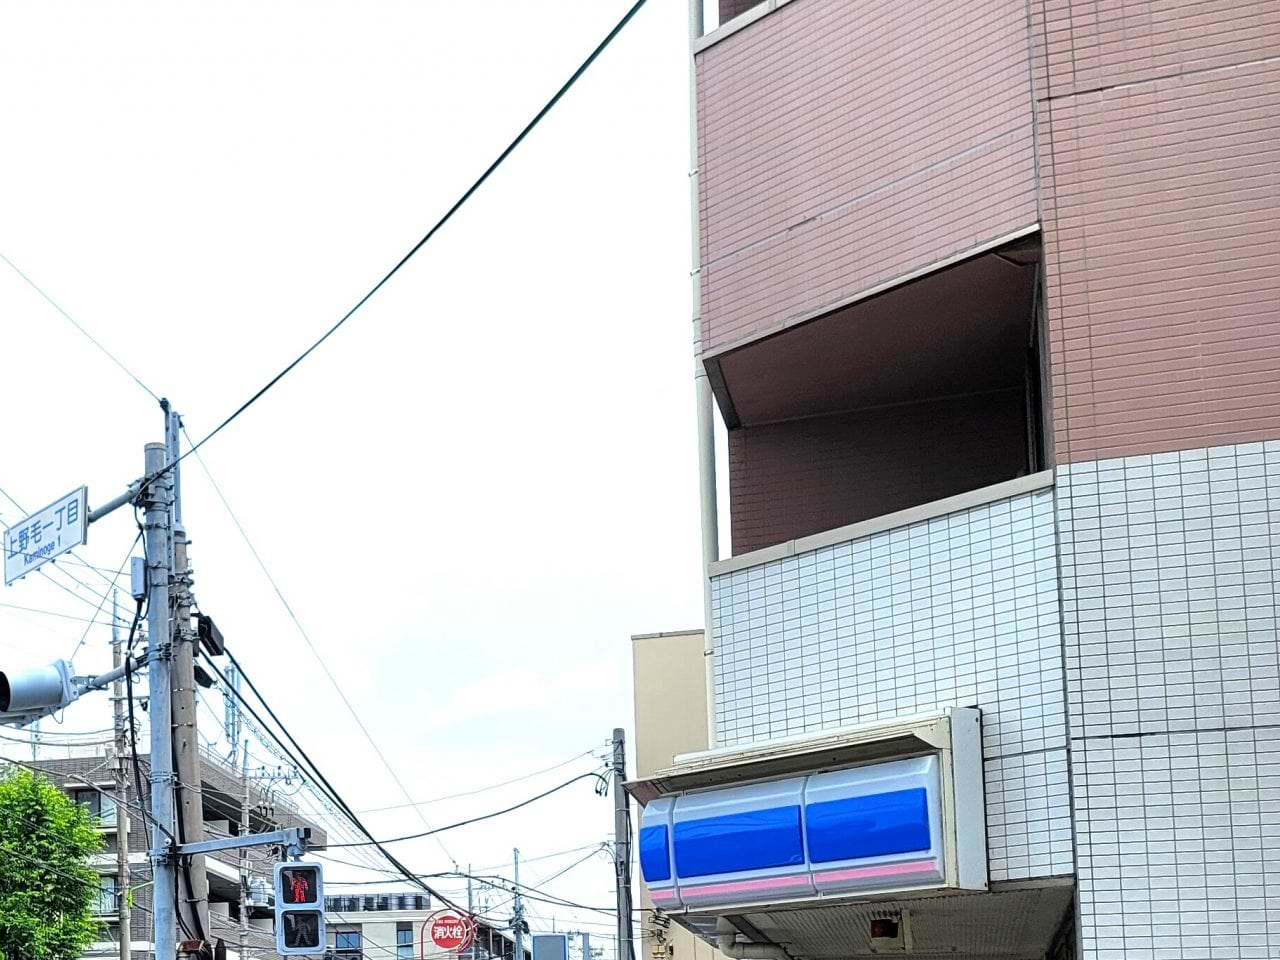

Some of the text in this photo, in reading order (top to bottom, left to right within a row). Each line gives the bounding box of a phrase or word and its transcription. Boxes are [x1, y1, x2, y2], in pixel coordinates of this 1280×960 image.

[7, 498, 79, 560] 上野毛一丁目
[433, 925, 464, 940] 消火栓
